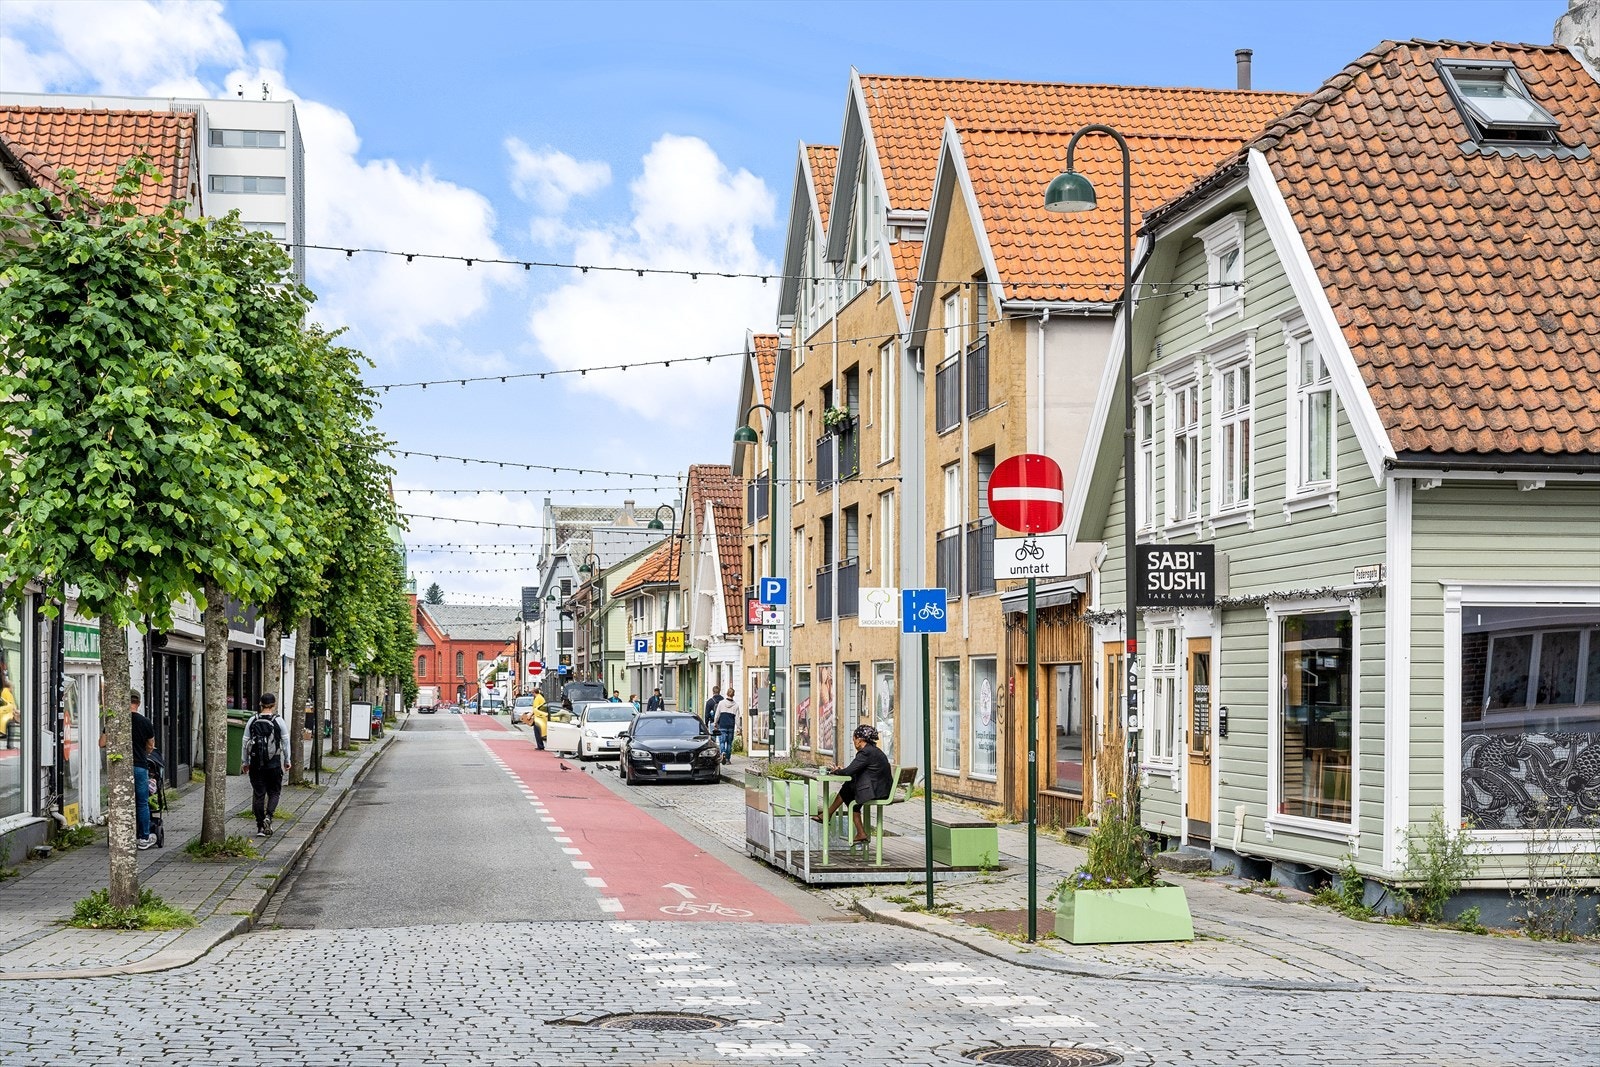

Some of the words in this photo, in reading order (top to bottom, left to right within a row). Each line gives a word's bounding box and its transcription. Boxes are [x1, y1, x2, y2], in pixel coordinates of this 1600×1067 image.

[1010, 563, 1049, 575] unntatt
[1147, 572, 1206, 591] SUSHI
[767, 581, 781, 601] P
[637, 641, 645, 651] P
